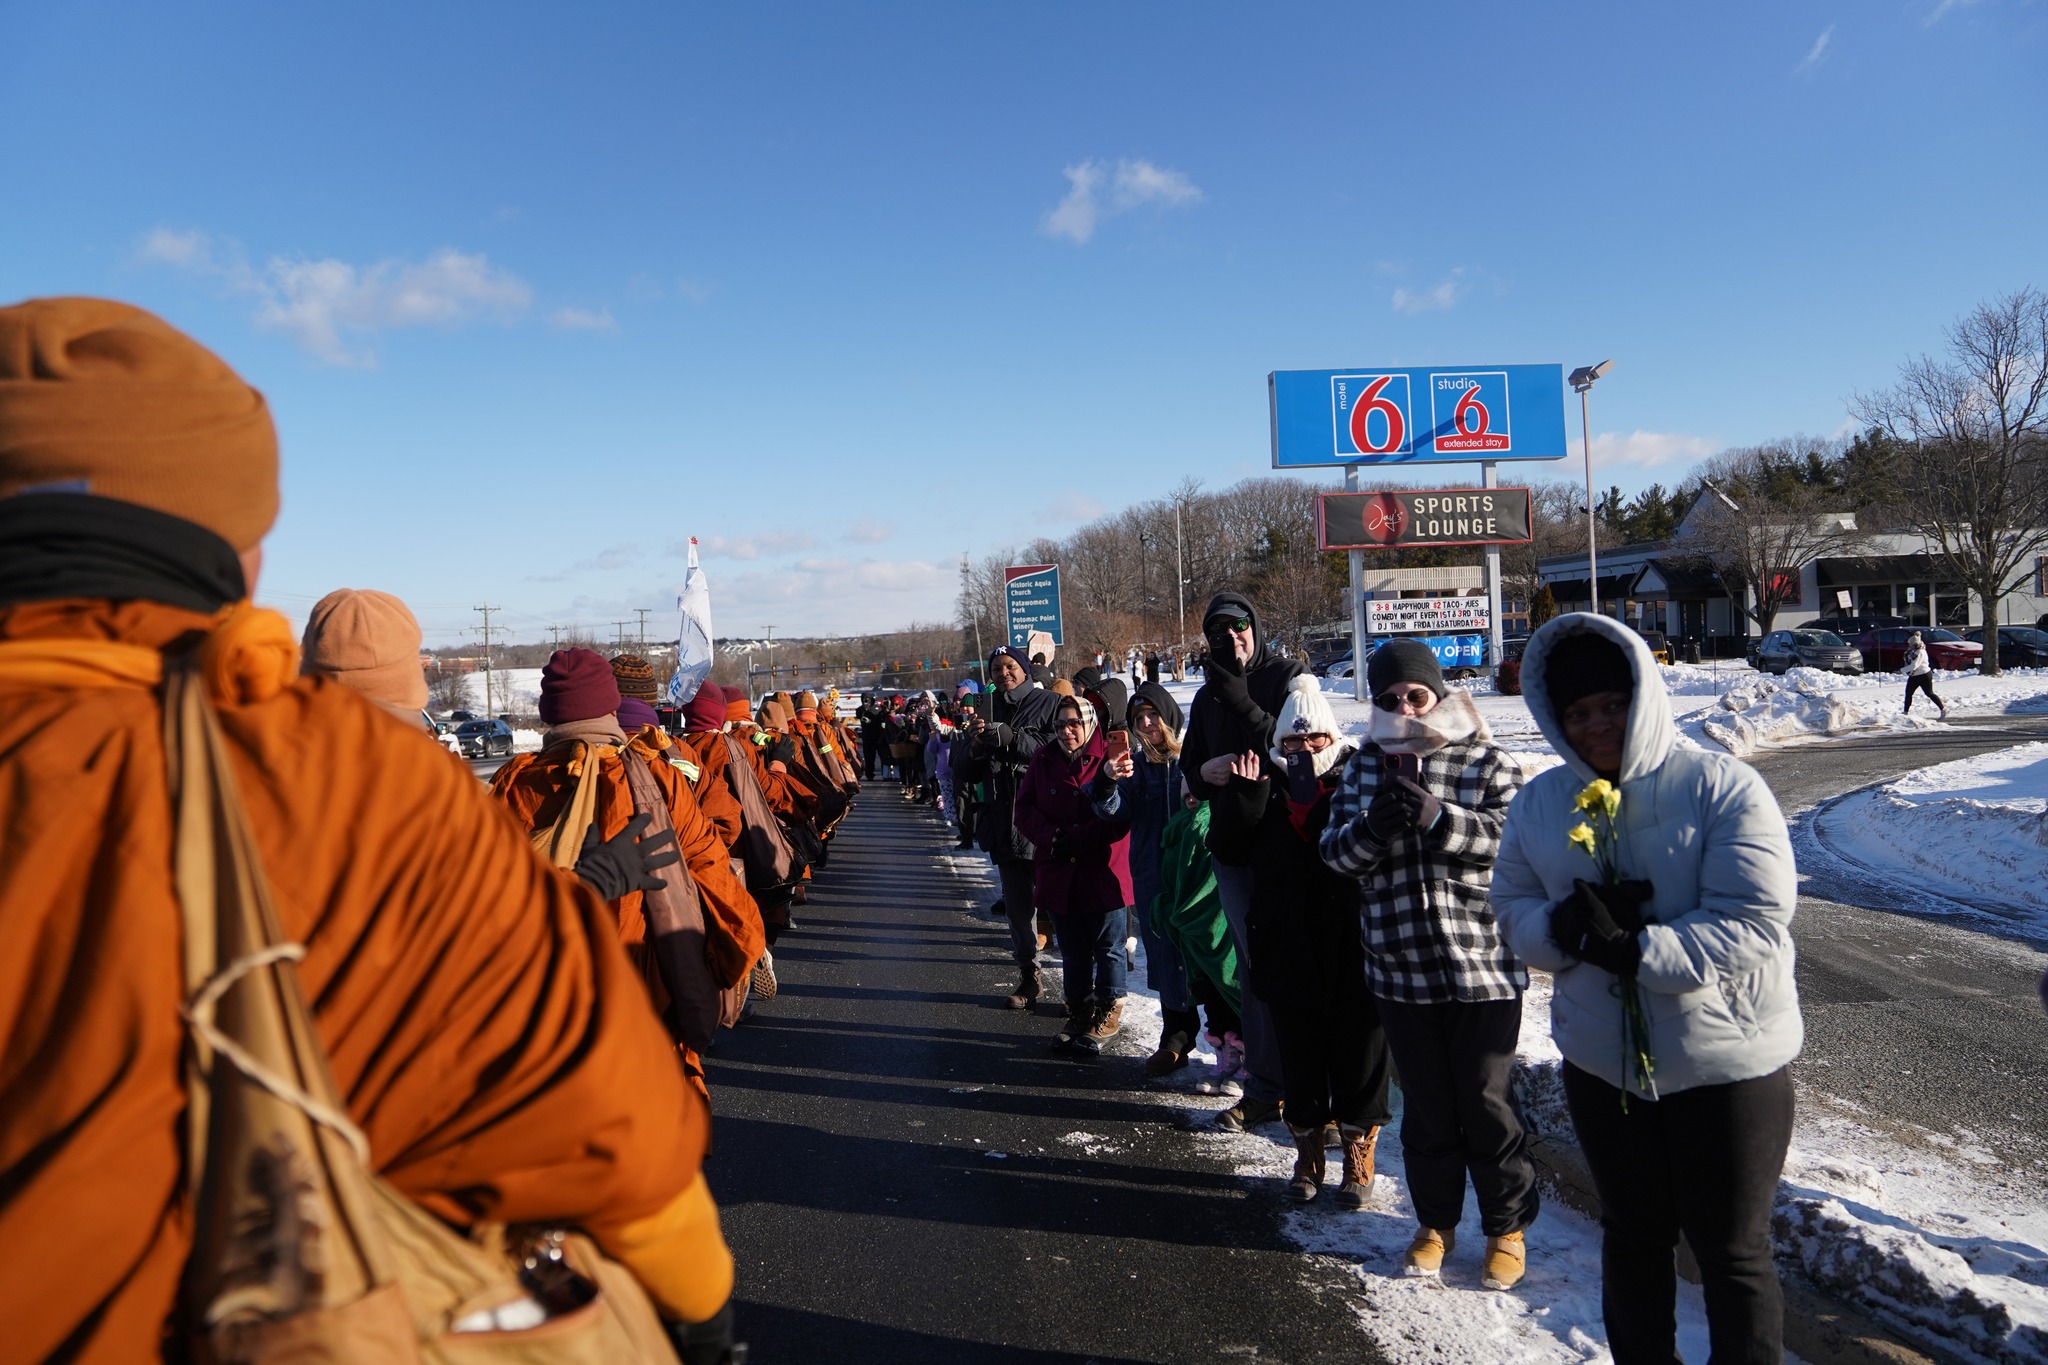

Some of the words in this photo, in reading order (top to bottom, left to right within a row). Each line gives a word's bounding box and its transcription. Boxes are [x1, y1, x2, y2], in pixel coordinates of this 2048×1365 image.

[1437, 378, 1477, 390] studio
[1337, 382, 1347, 410] motel
[1350, 376, 1405, 453] 6
[1454, 385, 1489, 436] 6
[1443, 438, 1483, 449] extended
[1485, 438, 1503, 449] stay
[1414, 496, 1494, 514] SPORTS
[1416, 518, 1497, 537] LOUNGE
[1372, 613, 1398, 621] COMEDY
[1400, 612, 1418, 620] NIGHT
[1473, 609, 1490, 617] TUES
[1390, 622, 1407, 630] THUR
[1031, 644, 1053, 653] STOP
[1444, 645, 1480, 657] OPEN
